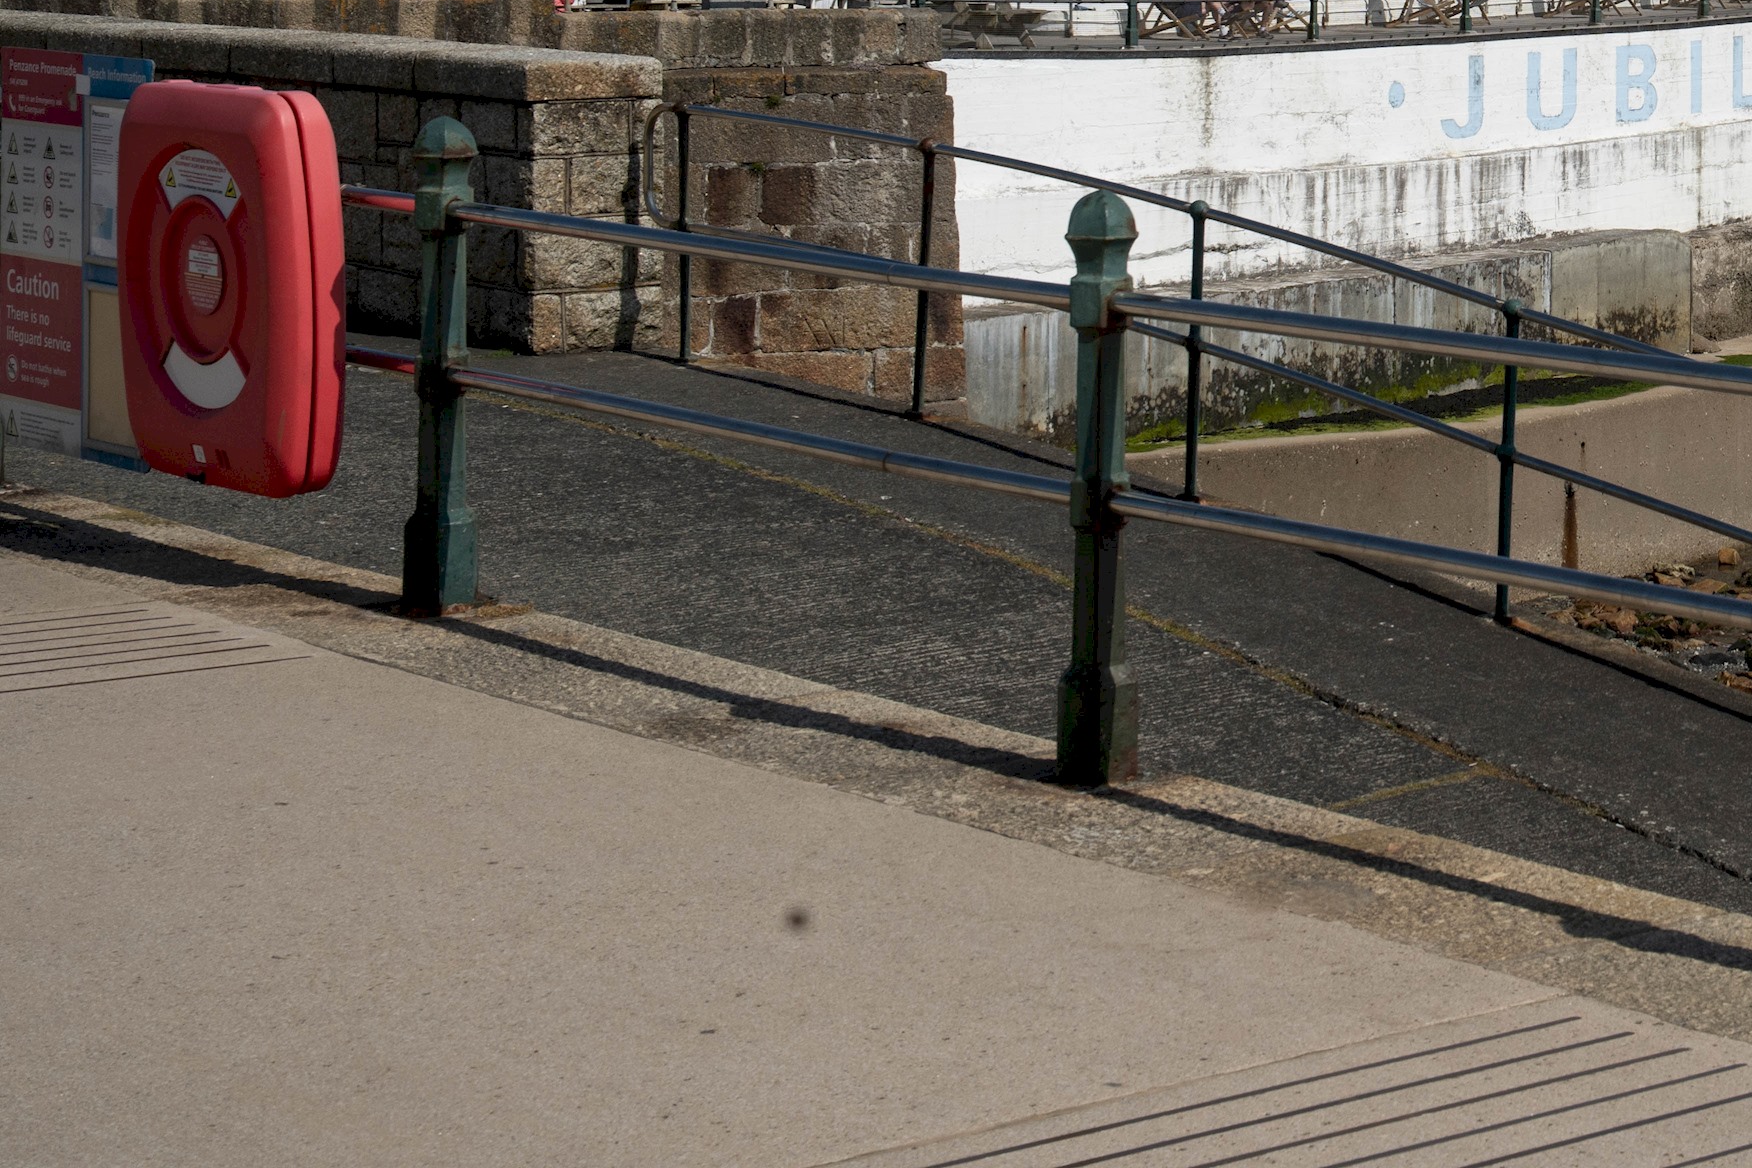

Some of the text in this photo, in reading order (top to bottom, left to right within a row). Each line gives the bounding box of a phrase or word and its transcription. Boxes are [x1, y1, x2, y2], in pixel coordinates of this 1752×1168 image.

[9, 59, 77, 77] Penzance Promenade
[88, 67, 147, 83] Beach Information
[7, 268, 59, 300] Caution
[7, 305, 49, 326] There is no
[6, 325, 72, 353] lifeguard service
[21, 360, 67, 376] Do not bathe when
[20, 374, 49, 388] sea is rough
